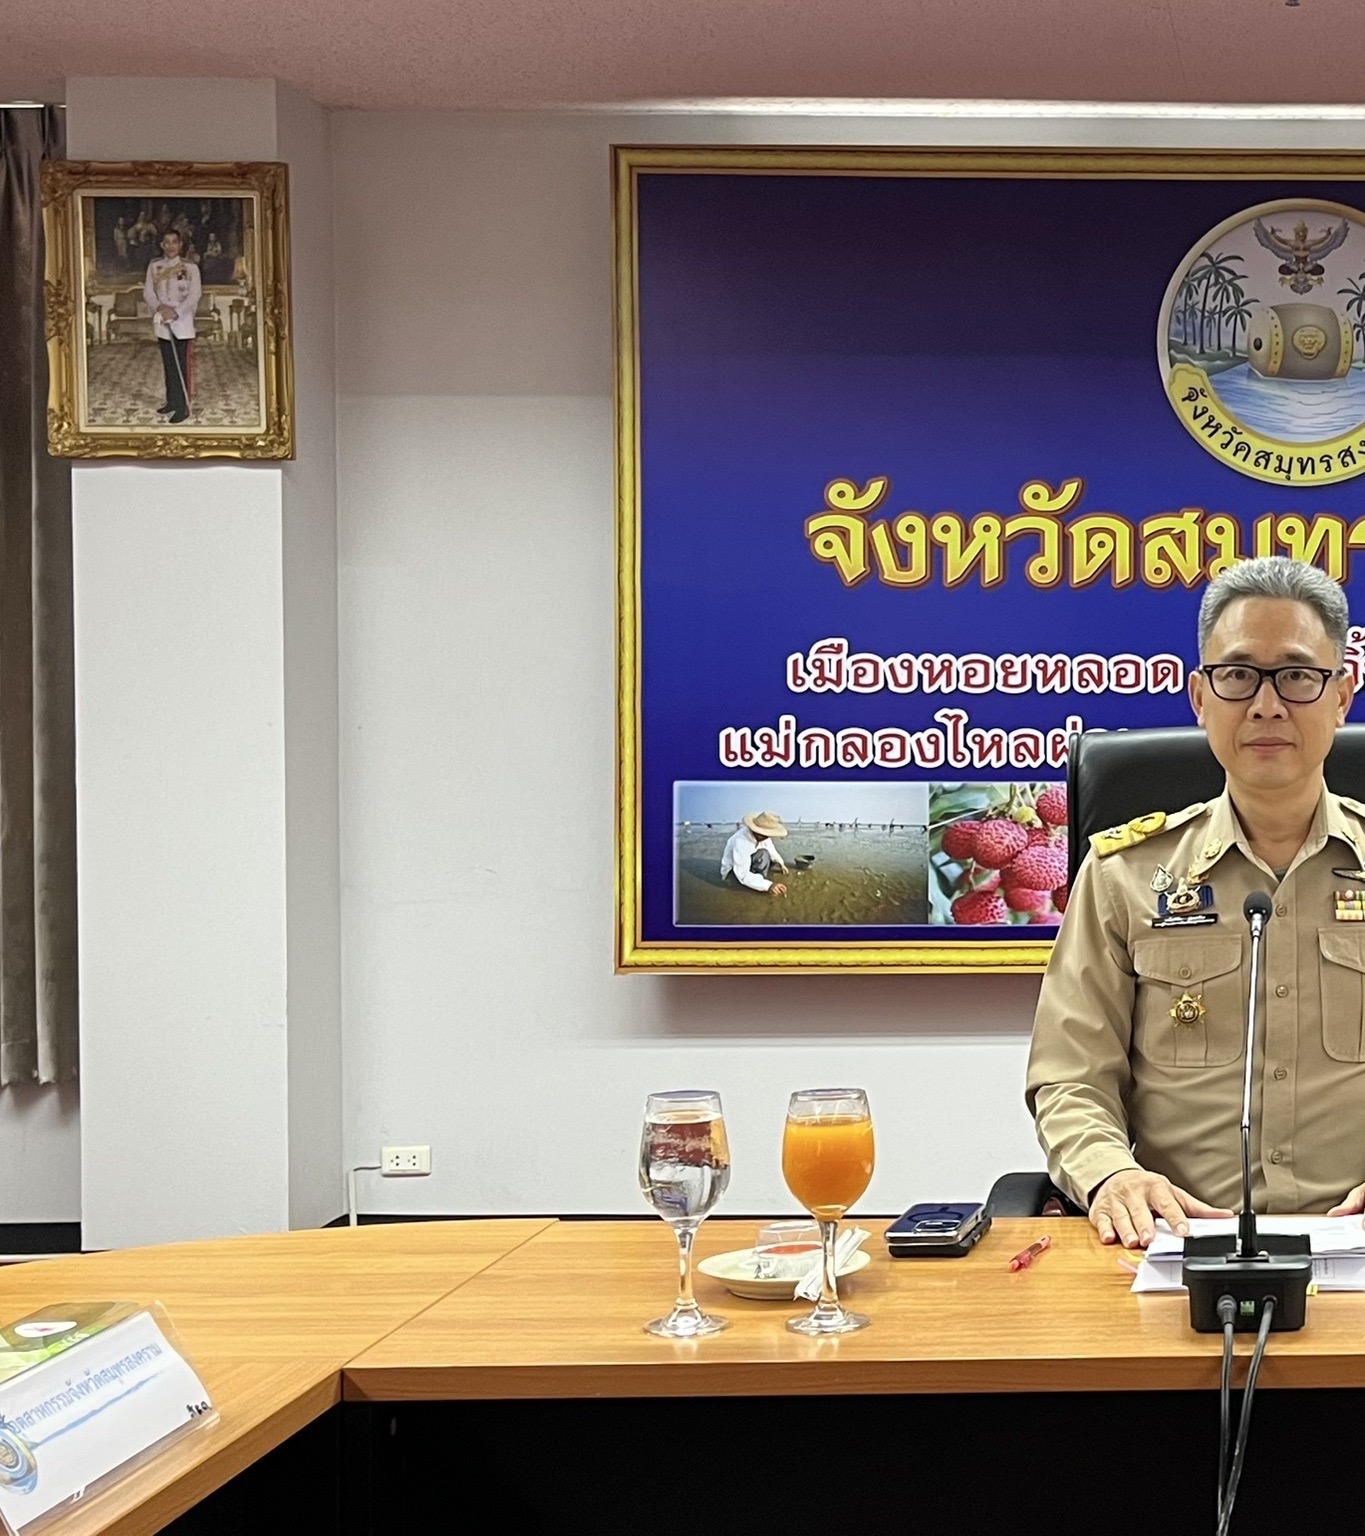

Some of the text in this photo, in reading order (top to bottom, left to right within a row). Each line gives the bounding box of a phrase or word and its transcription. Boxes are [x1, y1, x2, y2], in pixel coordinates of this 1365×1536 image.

[788, 639, 1184, 694] เมืองหอยหลอด
